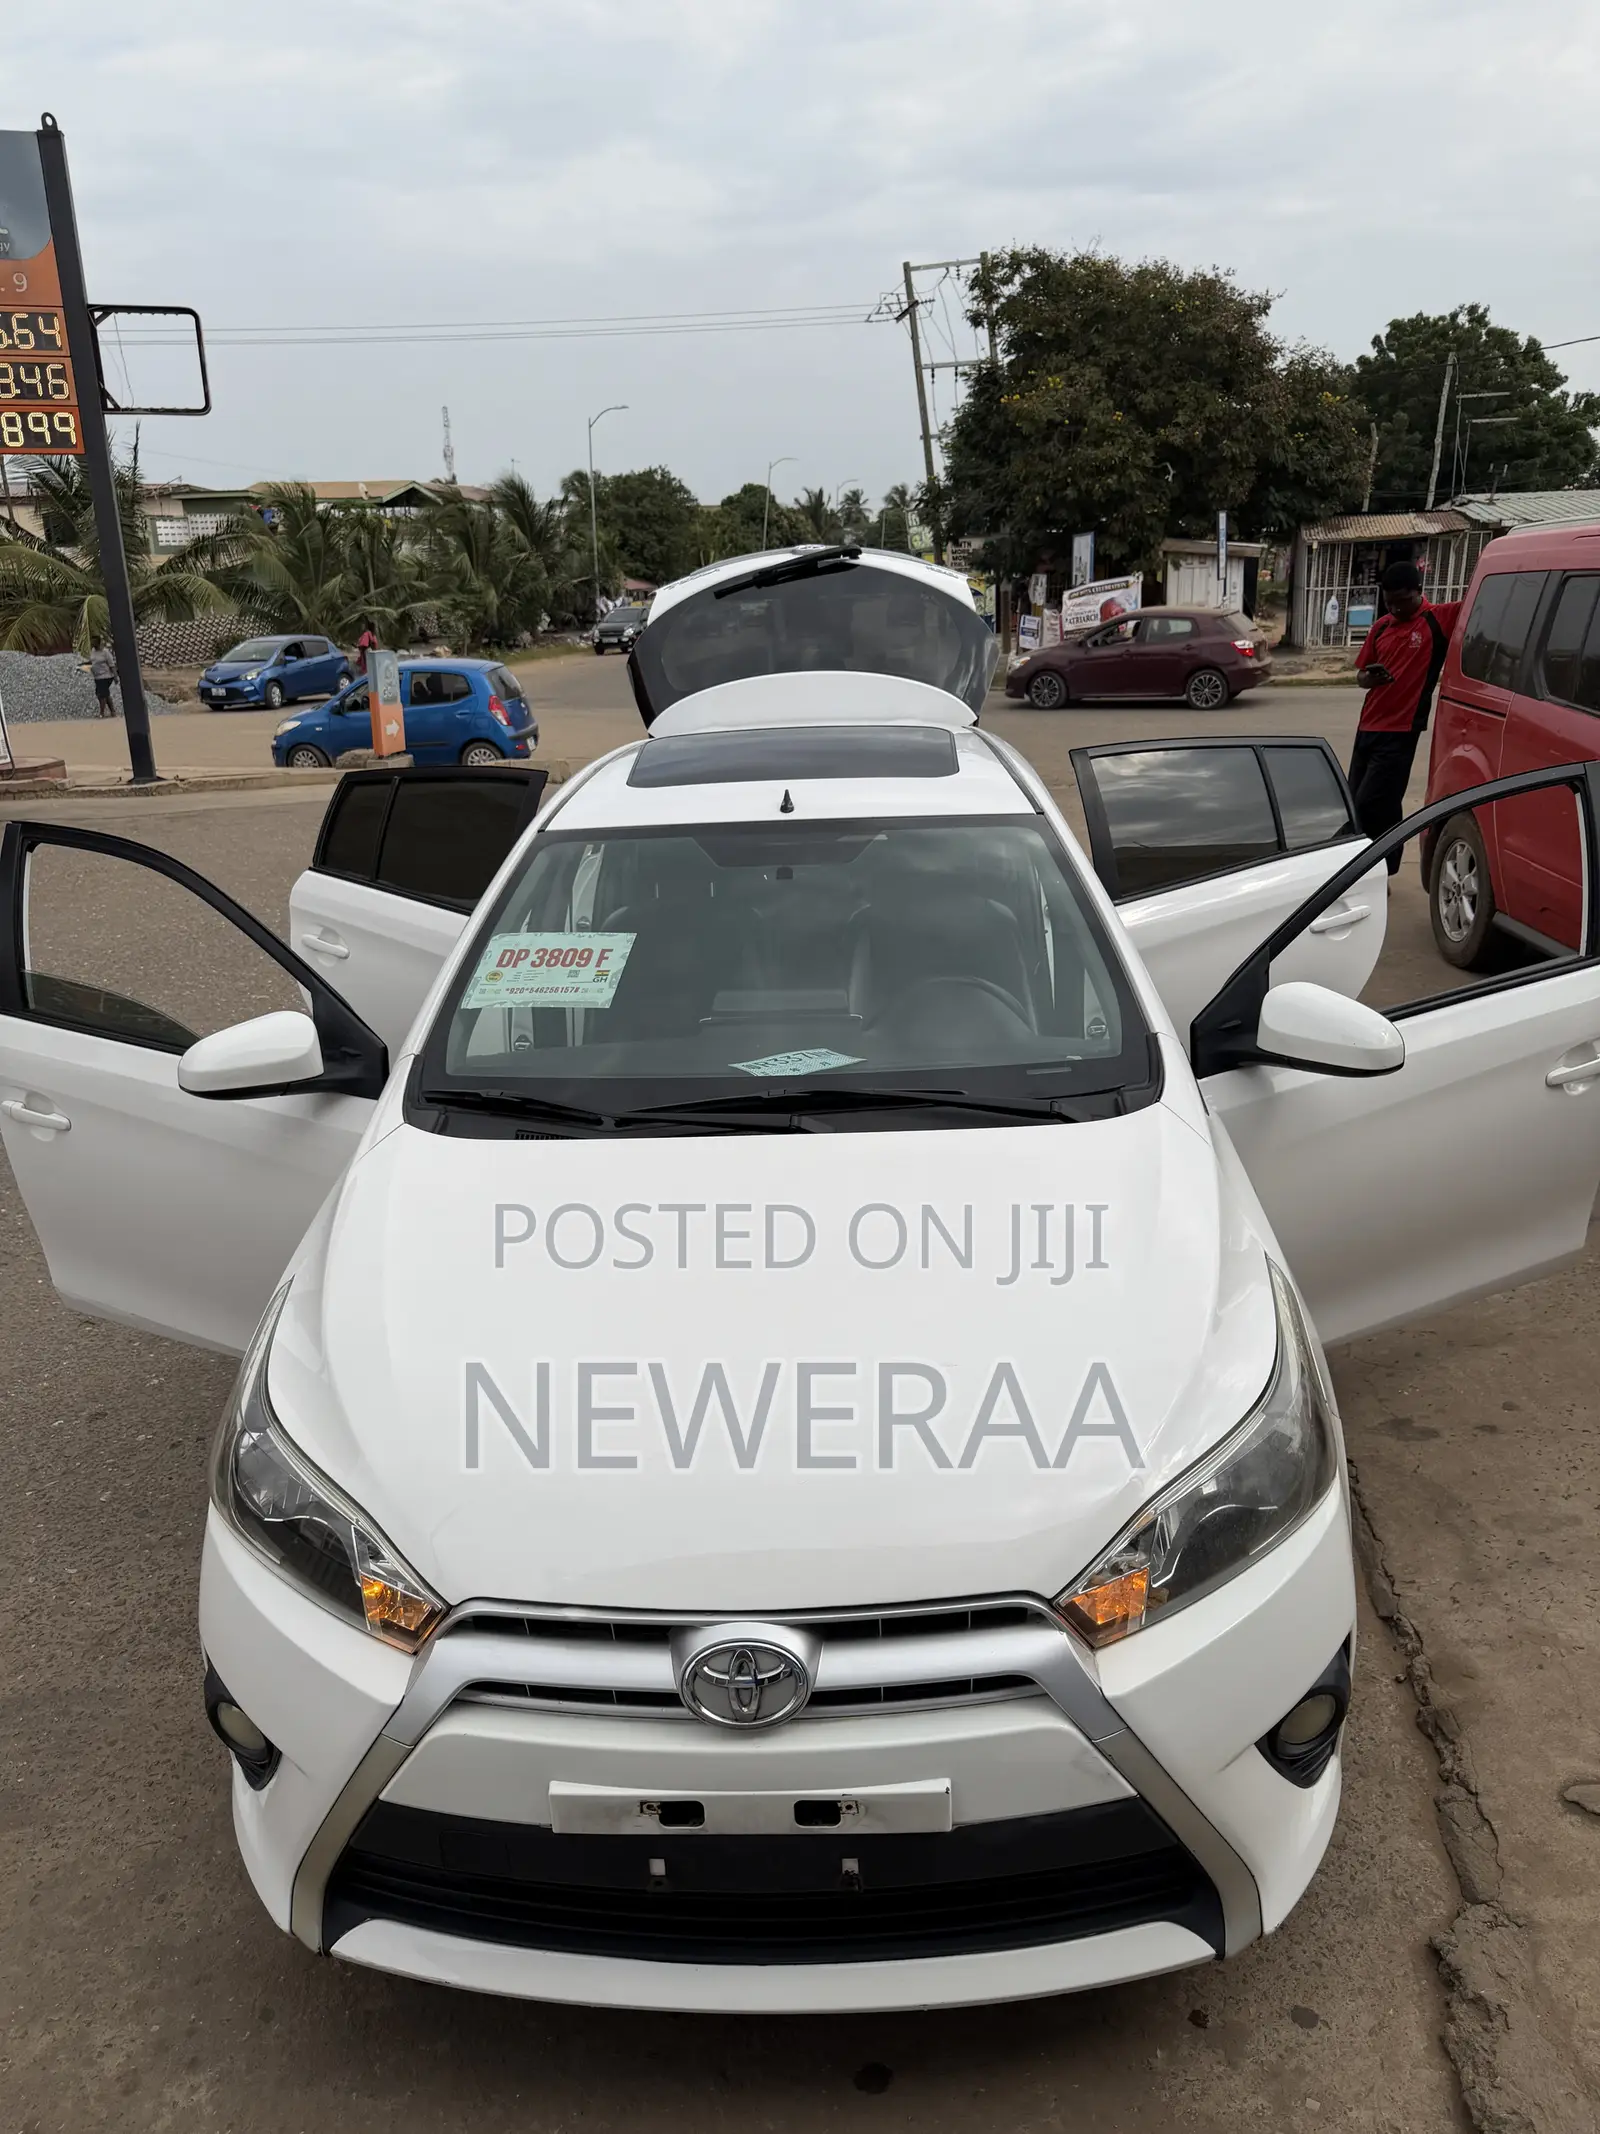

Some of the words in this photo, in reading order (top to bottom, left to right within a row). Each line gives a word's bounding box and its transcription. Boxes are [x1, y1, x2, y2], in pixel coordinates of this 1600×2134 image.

[496, 948, 530, 968] DP
[530, 947, 594, 968] 3809
[595, 948, 613, 968] F
